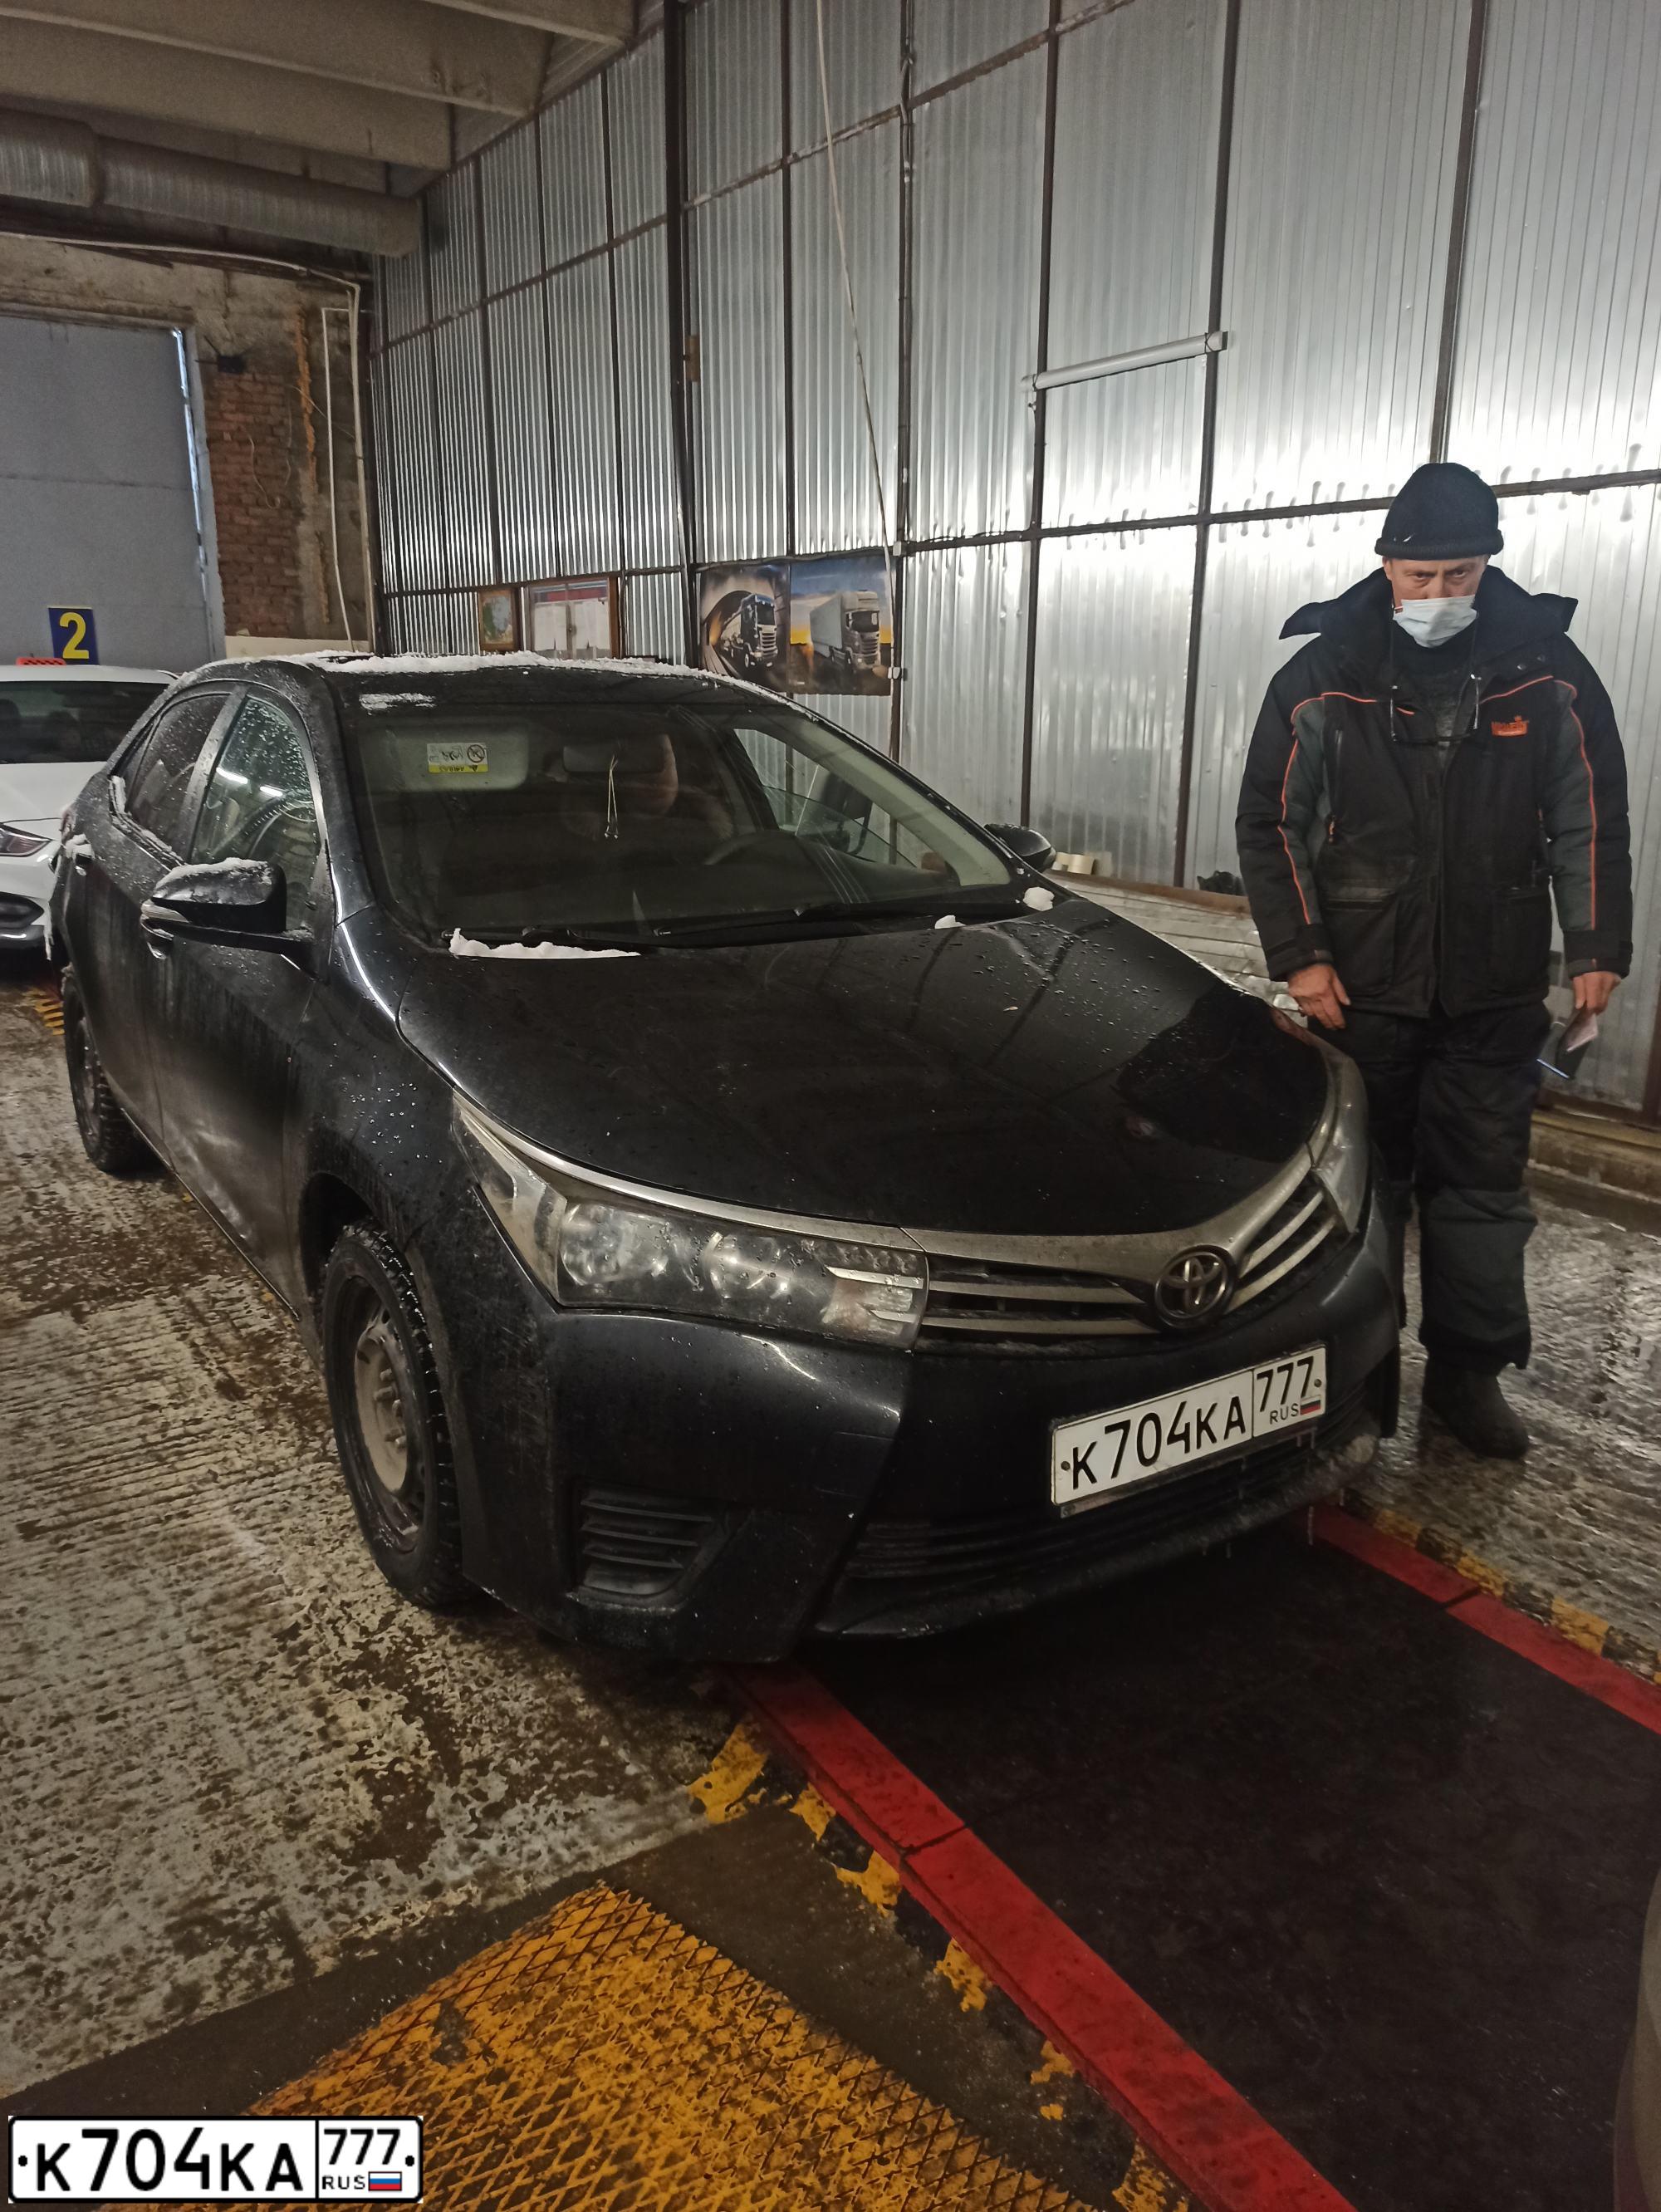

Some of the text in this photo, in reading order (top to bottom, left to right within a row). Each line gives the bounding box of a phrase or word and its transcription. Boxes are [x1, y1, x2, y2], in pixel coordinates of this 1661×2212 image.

[60, 612, 89, 659] 2
[1257, 1356, 1315, 1412] 777
[1270, 1404, 1299, 1425] RUS
